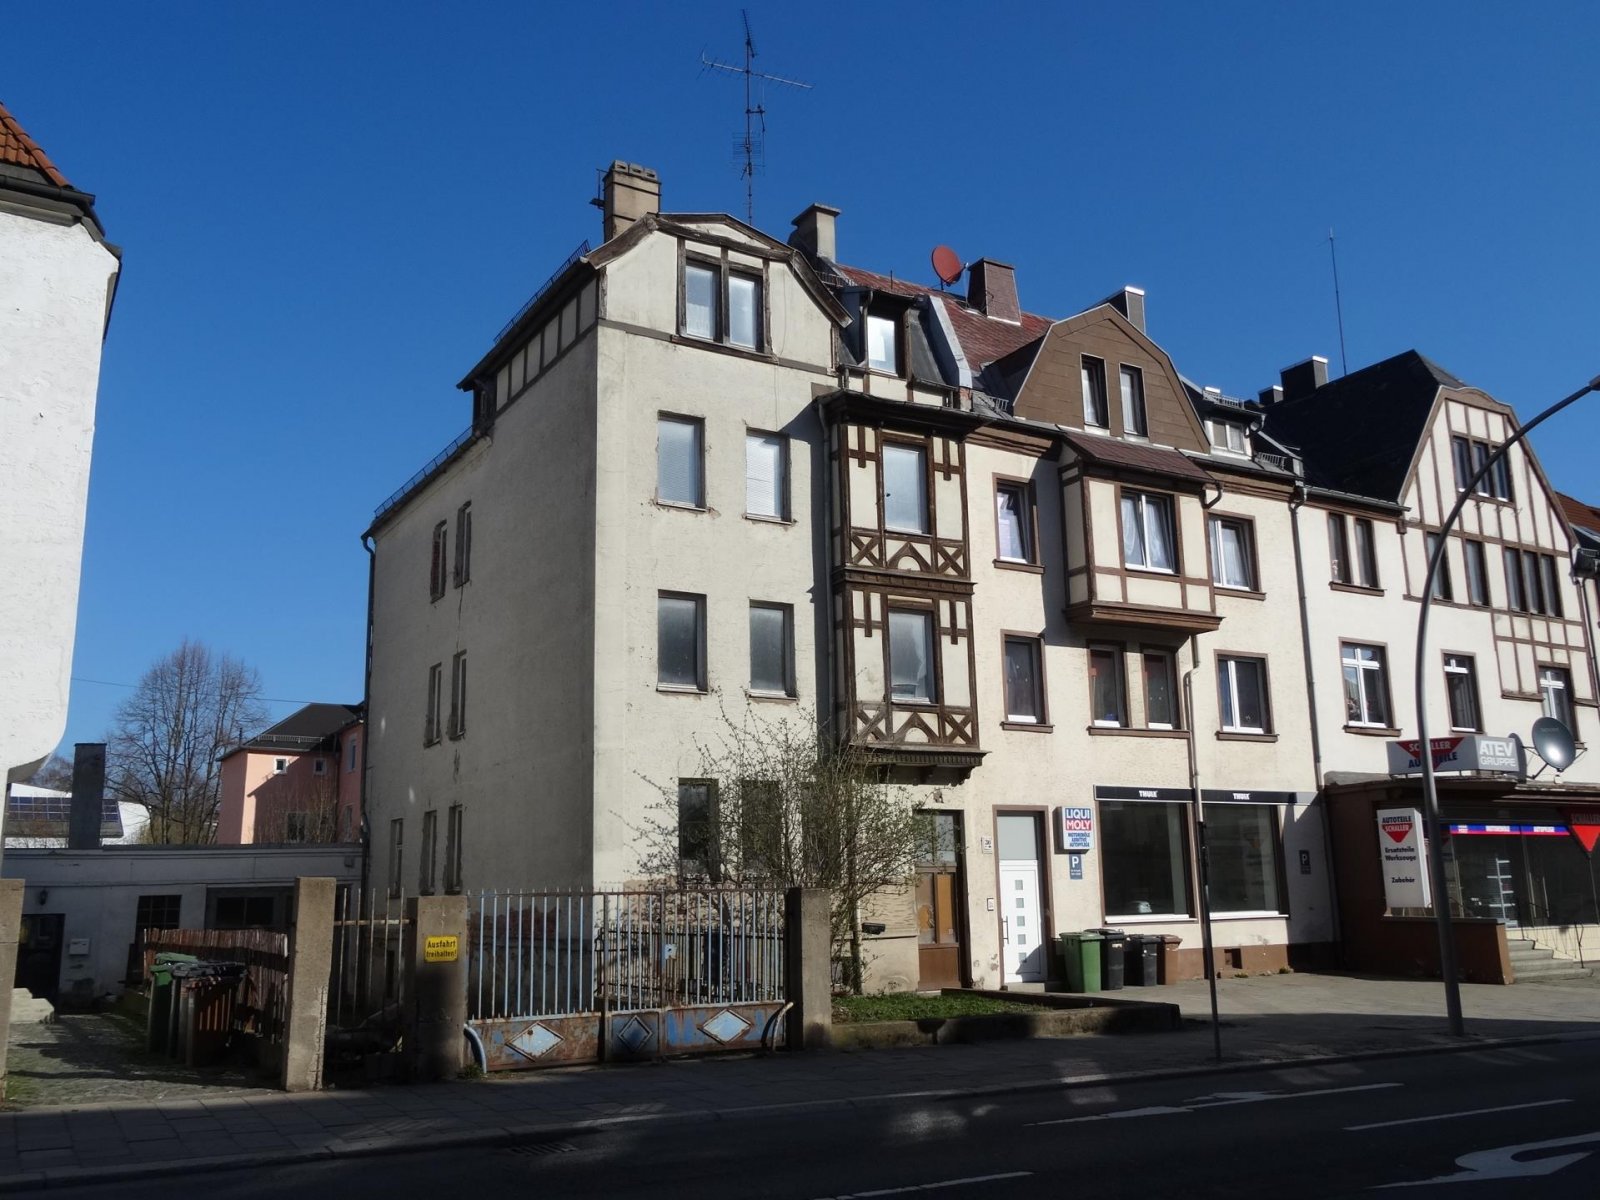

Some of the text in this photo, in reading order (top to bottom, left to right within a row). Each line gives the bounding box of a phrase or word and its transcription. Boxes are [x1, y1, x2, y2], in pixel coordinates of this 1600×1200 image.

[1408, 741, 1451, 752] SCLLER
[1480, 740, 1513, 756] ATEV
[1481, 757, 1516, 766] GRUPPE
[1066, 809, 1090, 819] LIQUI
[1066, 820, 1091, 830] MOLY
[1382, 816, 1411, 824] AUTOTEILE
[1072, 856, 1079, 868] P
[427, 940, 456, 948] Ausfahrt
